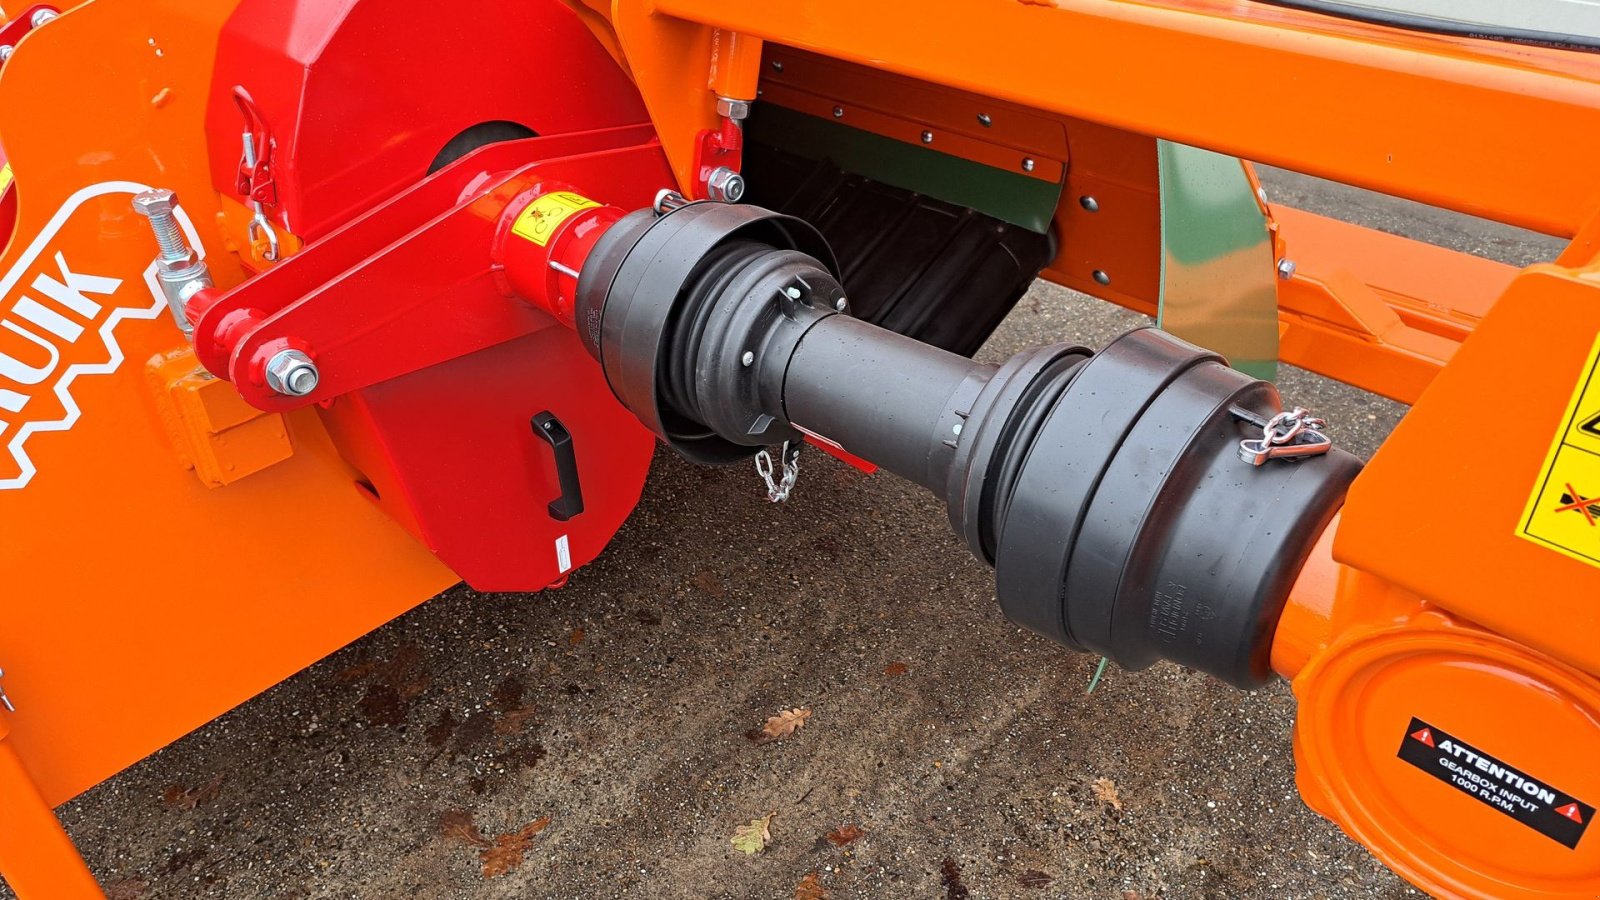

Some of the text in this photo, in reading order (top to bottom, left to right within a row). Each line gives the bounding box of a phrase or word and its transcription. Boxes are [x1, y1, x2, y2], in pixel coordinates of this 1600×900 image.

[0, 250, 124, 436] UIK
[1437, 739, 1556, 805] ATTENTION
[1438, 757, 1540, 813] GEARBOX INPUT
[1450, 773, 1516, 813] 1000 R.P.M.
